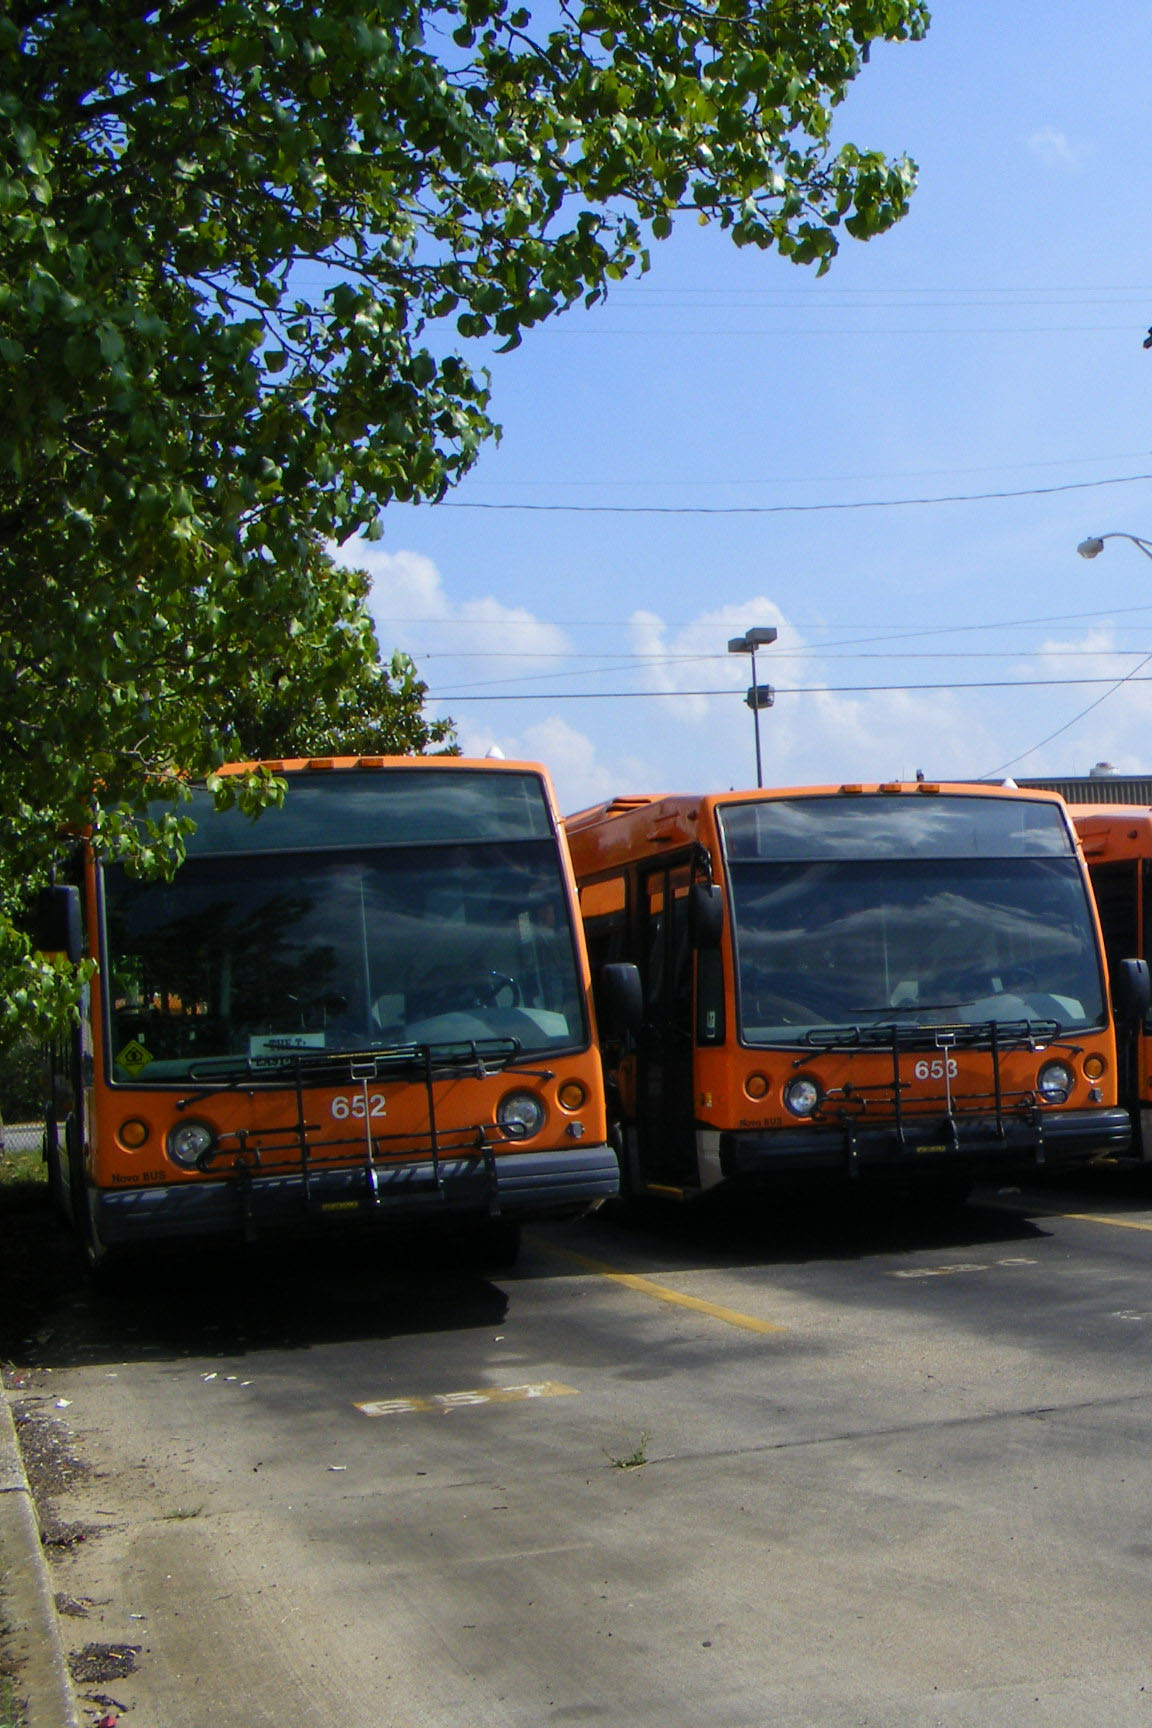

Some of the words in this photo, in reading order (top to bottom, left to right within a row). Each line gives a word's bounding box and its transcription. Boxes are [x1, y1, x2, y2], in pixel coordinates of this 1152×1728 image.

[914, 1058, 958, 1079] 653
[331, 1093, 387, 1119] 652
[112, 1172, 139, 1184] Nova
[143, 1170, 167, 1182] BUS
